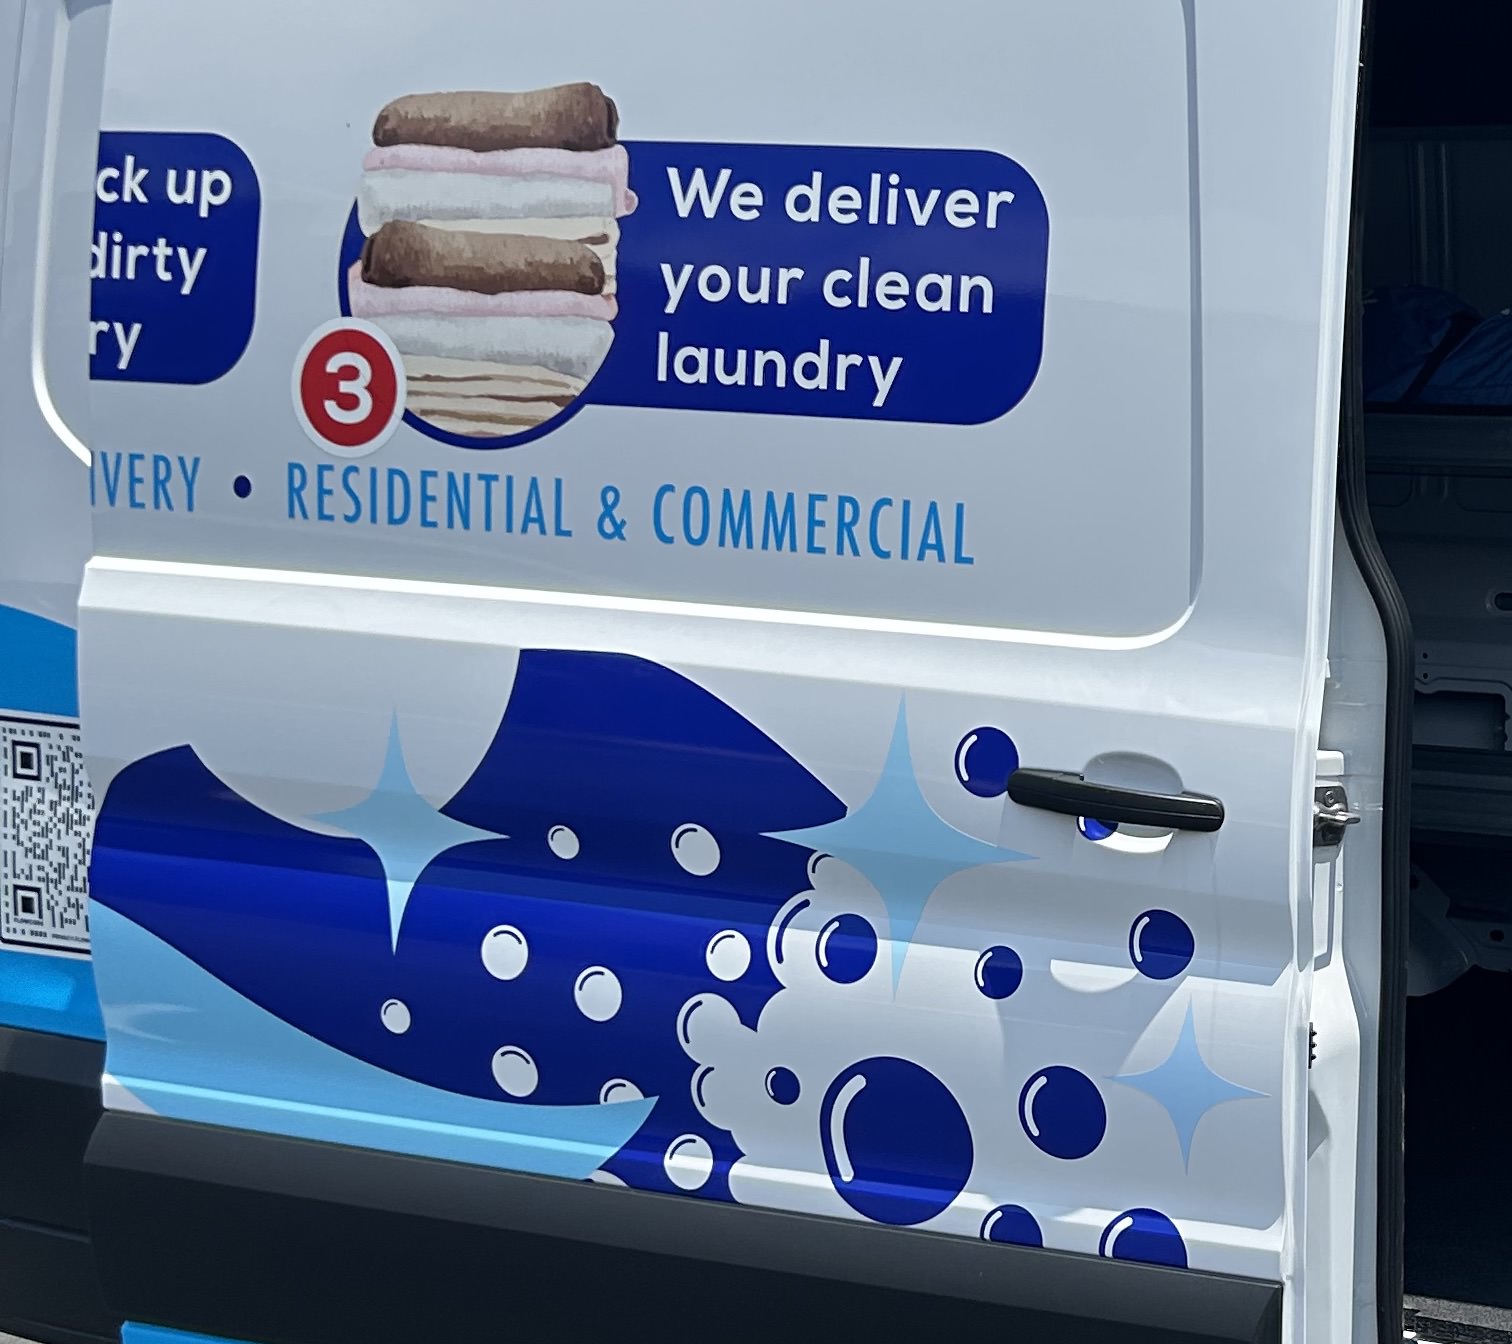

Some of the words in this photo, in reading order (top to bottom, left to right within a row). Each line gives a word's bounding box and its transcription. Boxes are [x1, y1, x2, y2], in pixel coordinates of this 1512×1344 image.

[166, 168, 233, 218] up
[666, 166, 764, 222] We
[784, 171, 1015, 230] deliver
[89, 231, 207, 296] dirty
[660, 262, 805, 315] your
[822, 256, 994, 315] clean
[323, 352, 374, 425] 3
[657, 331, 904, 408] laundry
[287, 462, 573, 539] RESIDENTIAL
[597, 484, 629, 543] &
[653, 483, 976, 566] COMMERCIAL
